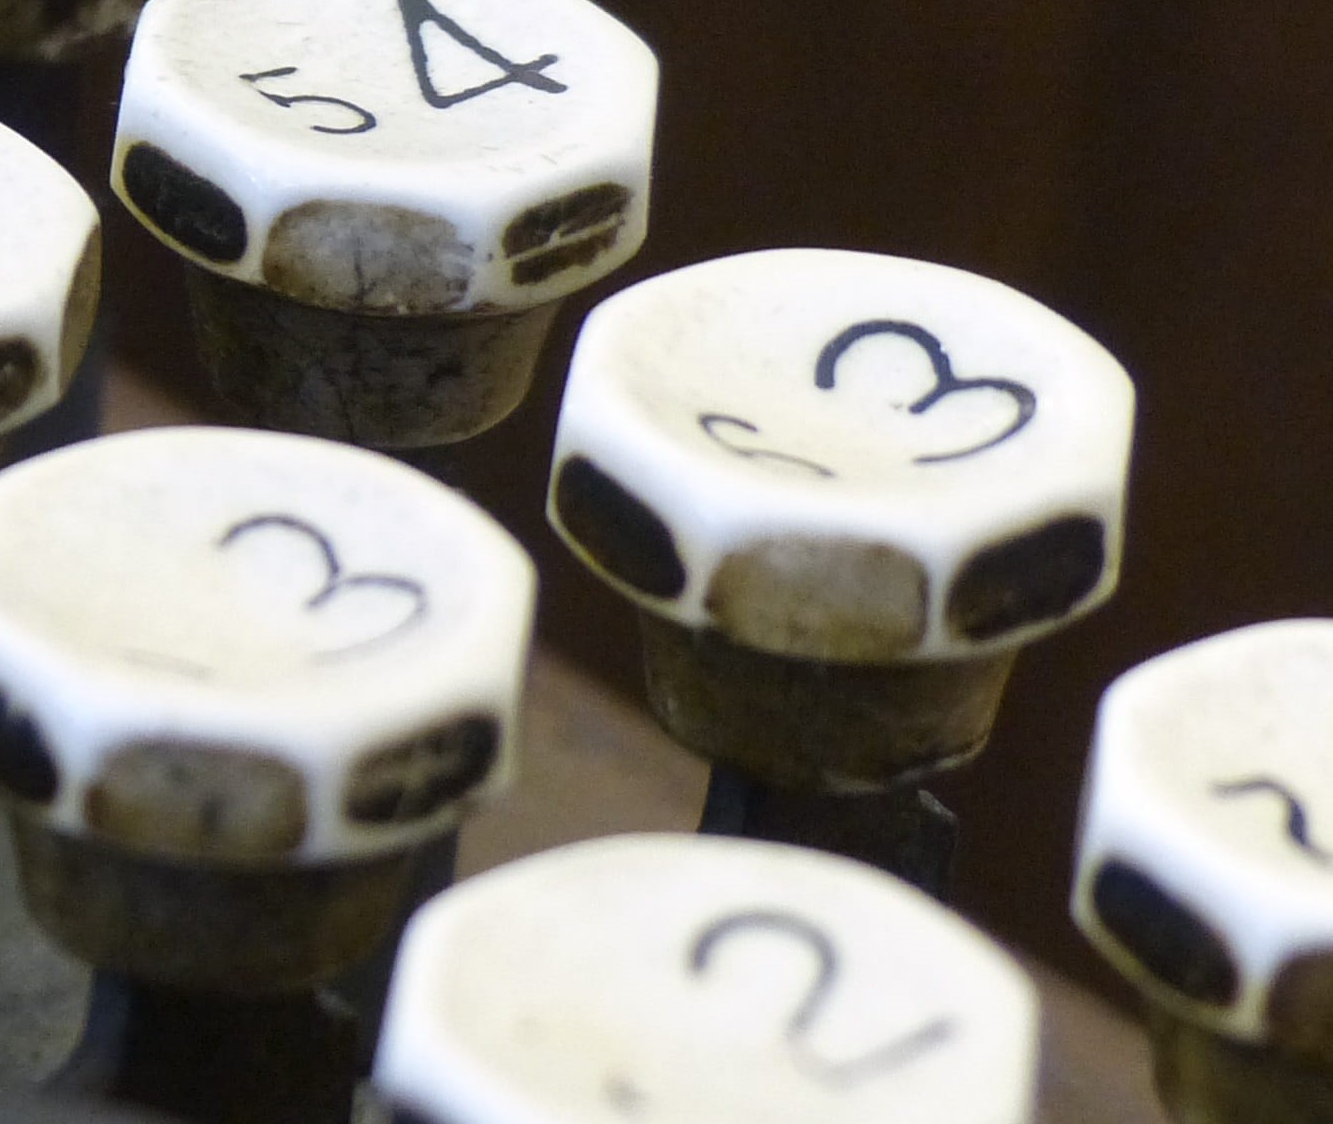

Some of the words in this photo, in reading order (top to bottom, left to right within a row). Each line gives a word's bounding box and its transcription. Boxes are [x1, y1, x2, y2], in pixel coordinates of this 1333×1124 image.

[238, 66, 378, 136] 5
[814, 319, 1036, 466] 3
[218, 514, 428, 668] 3
[686, 910, 958, 1090] 2
